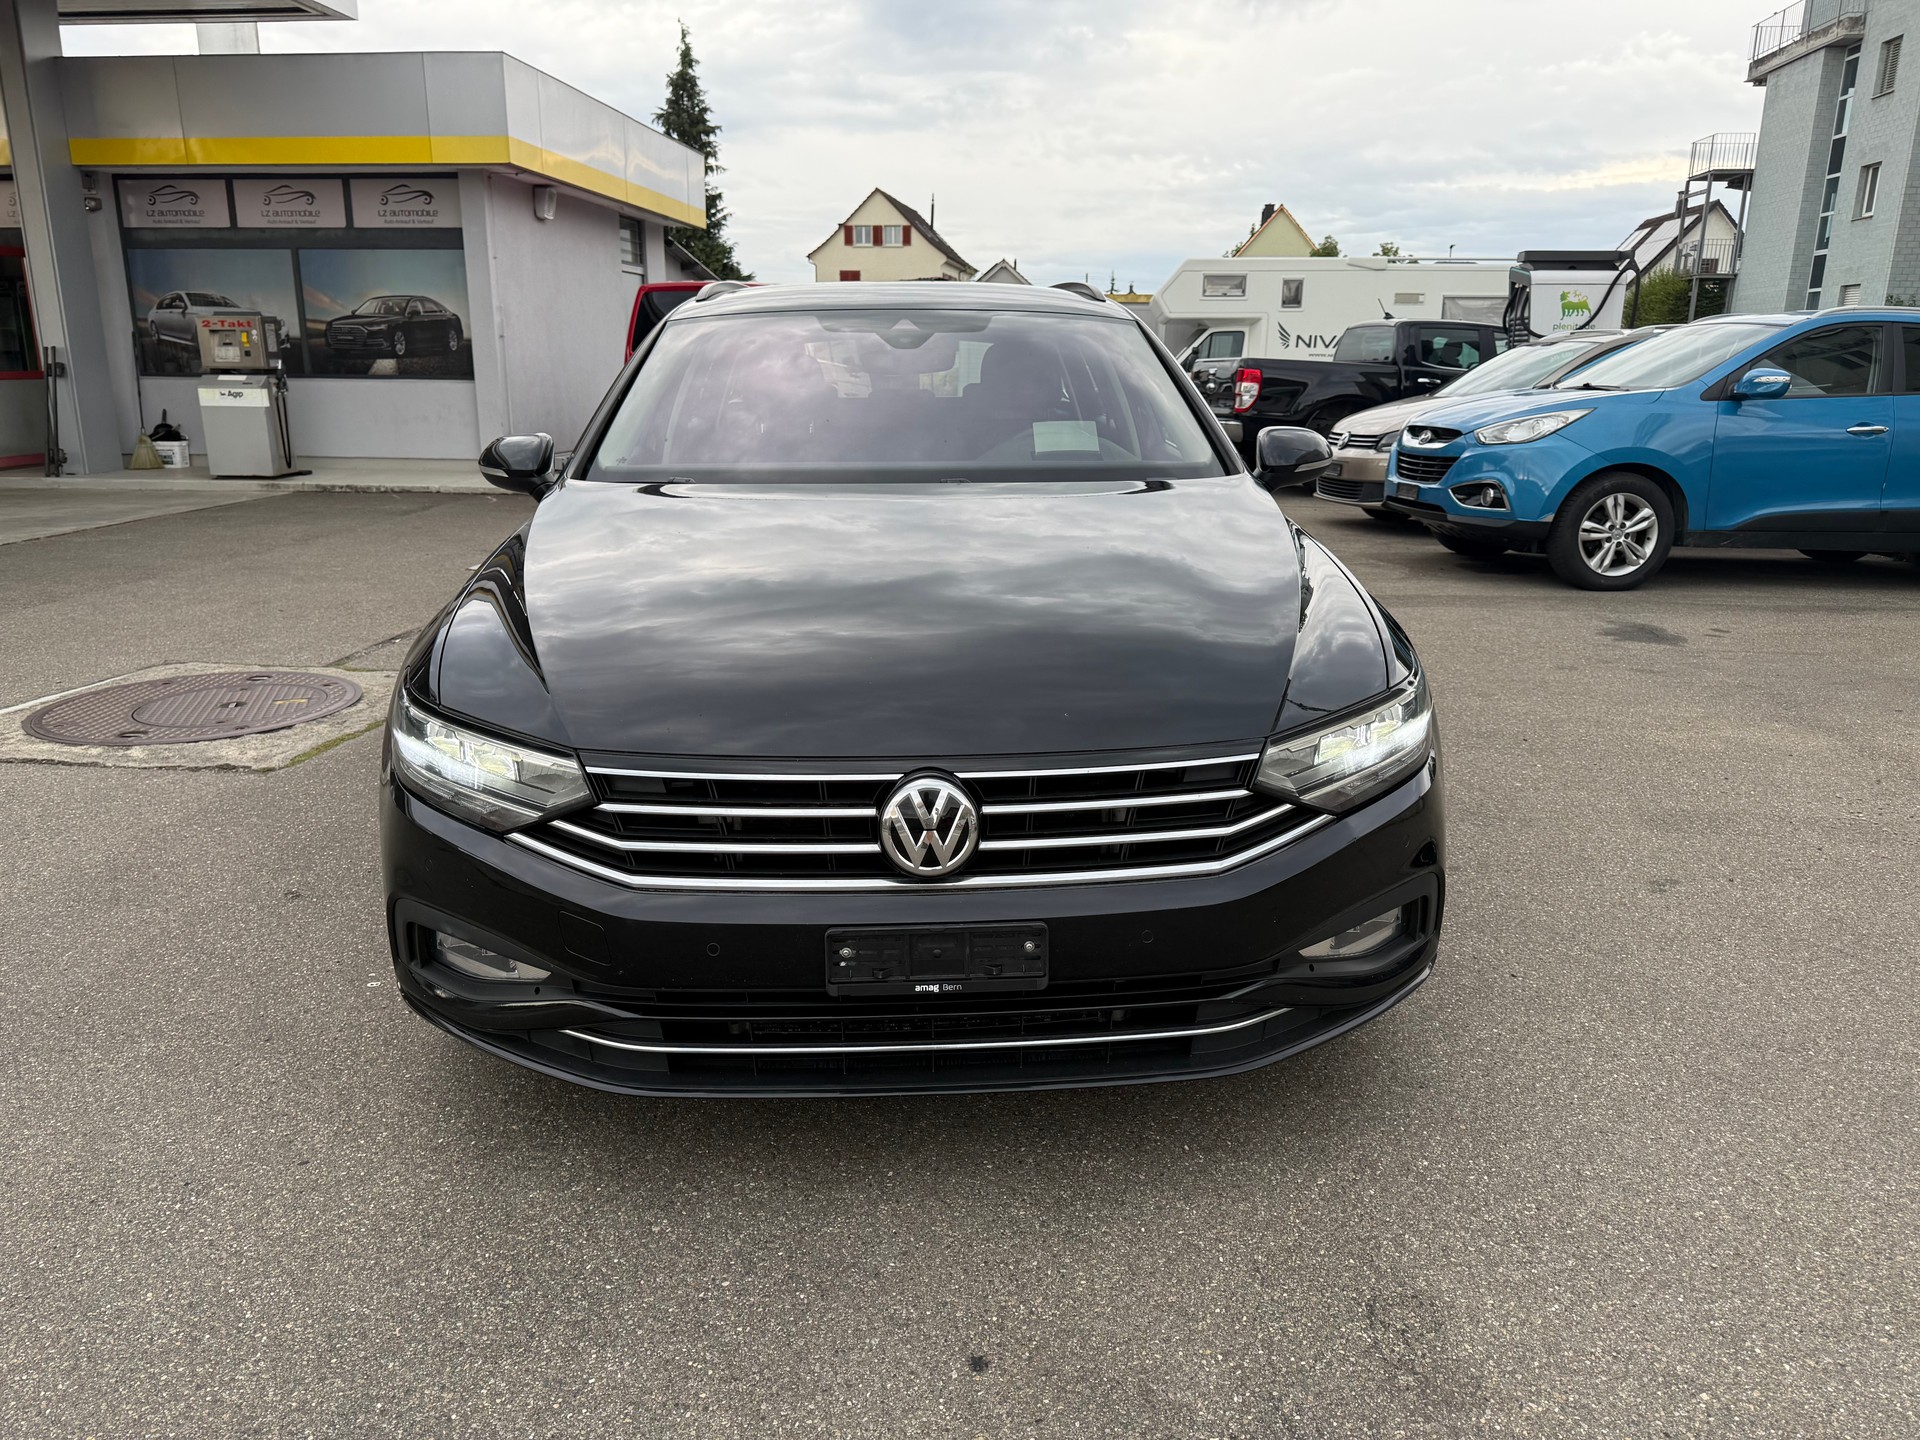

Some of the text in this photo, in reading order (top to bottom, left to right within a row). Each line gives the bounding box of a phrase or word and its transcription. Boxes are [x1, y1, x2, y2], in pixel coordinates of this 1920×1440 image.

[202, 320, 252, 328] 2-Takt
[914, 983, 963, 993] amag Bern
